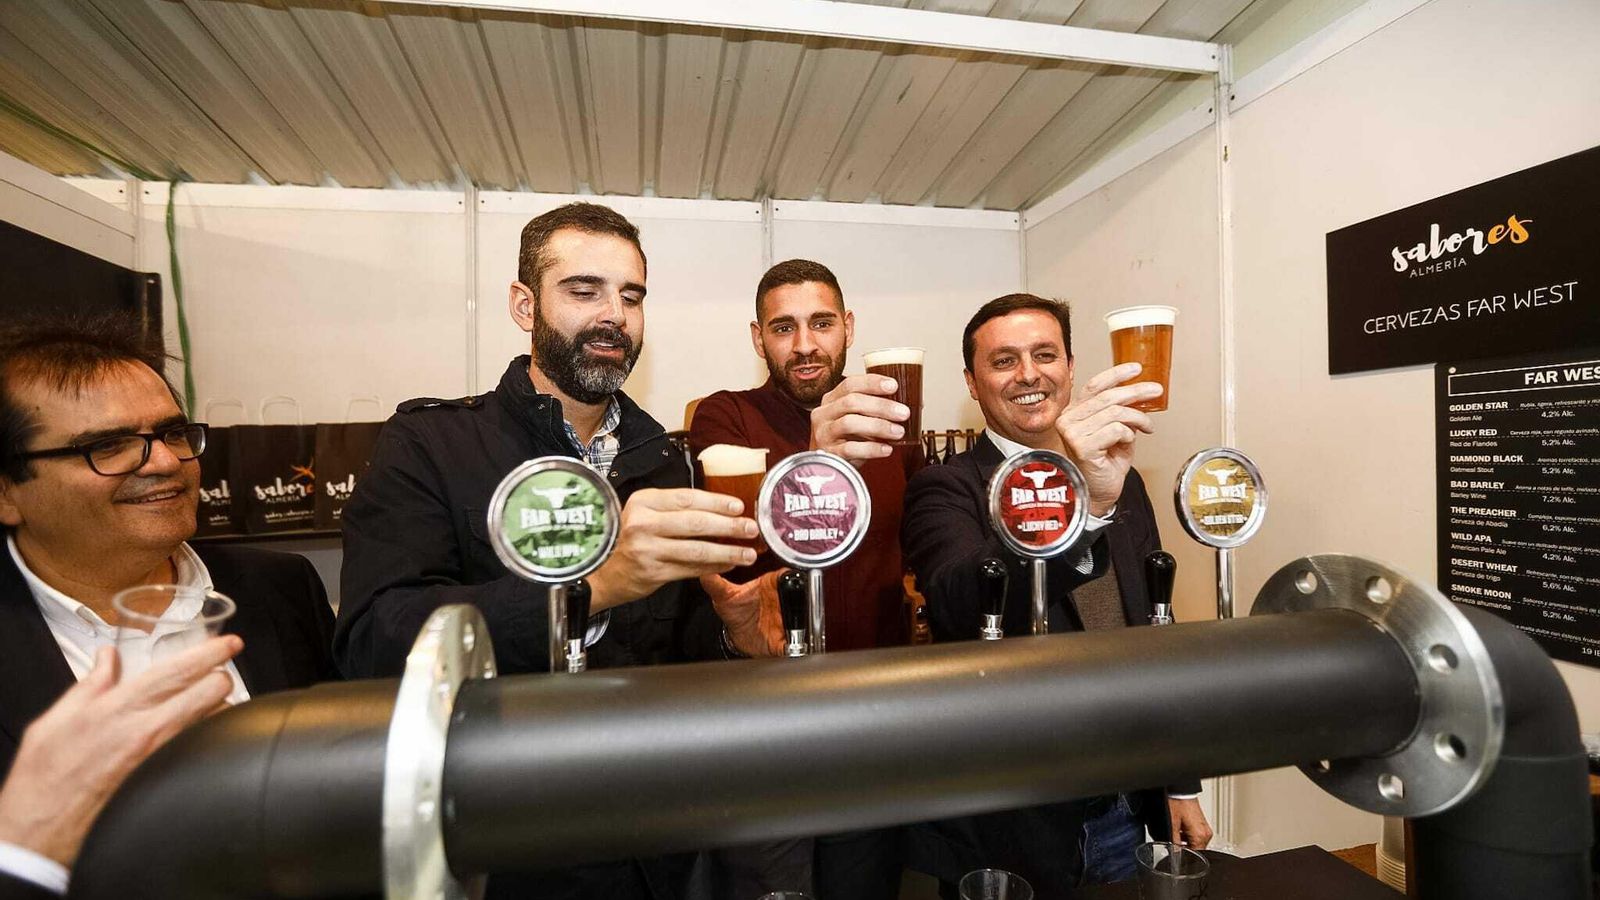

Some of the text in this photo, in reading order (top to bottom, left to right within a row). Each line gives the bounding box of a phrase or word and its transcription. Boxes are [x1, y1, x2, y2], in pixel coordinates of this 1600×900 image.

[1391, 214, 1533, 272] sabores
[1363, 282, 1578, 334] CERVEZAS FAR WEST
[1524, 366, 1600, 385] FAR WES
[1449, 402, 1508, 412] GOLDEN STAR
[255, 477, 315, 500] sabore
[1470, 481, 1505, 489] BARLEY
[1011, 488, 1035, 506] FAR
[1198, 484, 1219, 500] FAR
[1450, 492, 1469, 500] Barley
[784, 493, 810, 512] FAR
[1563, 496, 1576, 504] Alc.
[520, 508, 550, 529] FAR
[1468, 508, 1516, 517] PREACHER
[1451, 518, 1474, 526] Cerveza
[794, 528, 838, 541] BAD BARLEY
[1451, 532, 1492, 543] WILD APA
[1451, 544, 1480, 553] American
[1481, 546, 1494, 554] Pale
[1542, 553, 1577, 563] 4,2% Alc.
[1451, 558, 1518, 572] DESERT WHEAT
[1451, 569, 1476, 578] Cerveza
[1486, 574, 1501, 582] trigo
[1451, 584, 1512, 599] SMOKE MOON
[1542, 581, 1577, 592] 5,6% Alc.
[1451, 595, 1476, 604] Cerveza
[1543, 610, 1577, 622] 5,2% Alc.
[1582, 647, 1593, 655] 19
